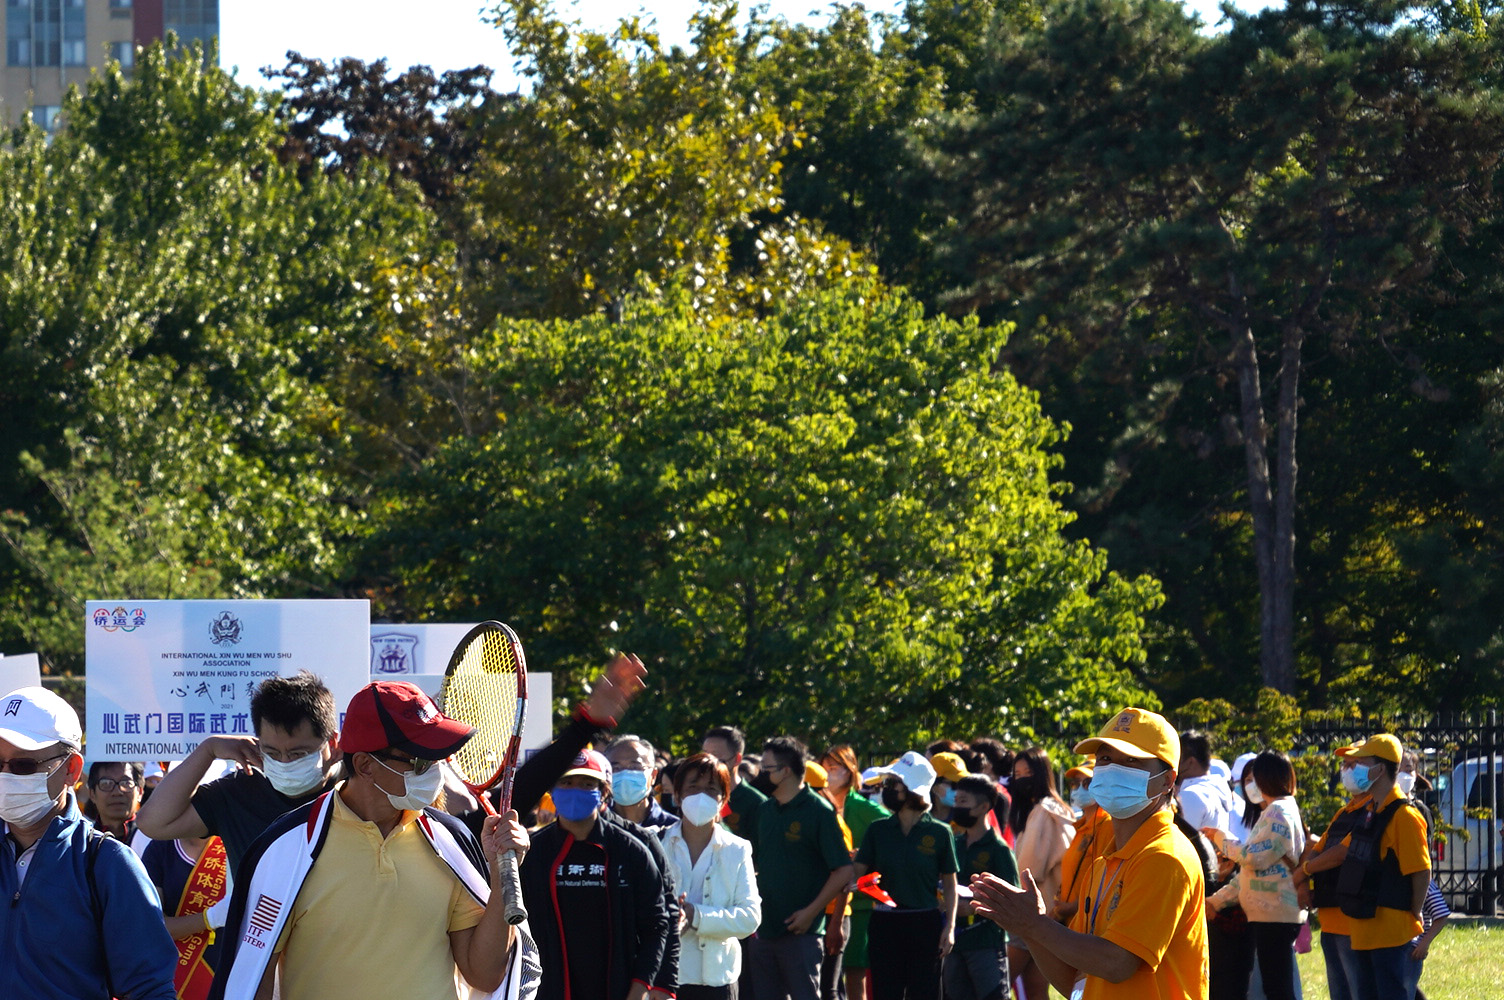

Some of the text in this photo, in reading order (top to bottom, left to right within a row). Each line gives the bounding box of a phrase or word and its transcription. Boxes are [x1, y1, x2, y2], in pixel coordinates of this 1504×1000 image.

[94, 616, 146, 626] 侨运会
[102, 712, 249, 734] 心武门国际武术
[105, 742, 184, 755] INTERNATIONAL
[179, 936, 202, 966] Game
